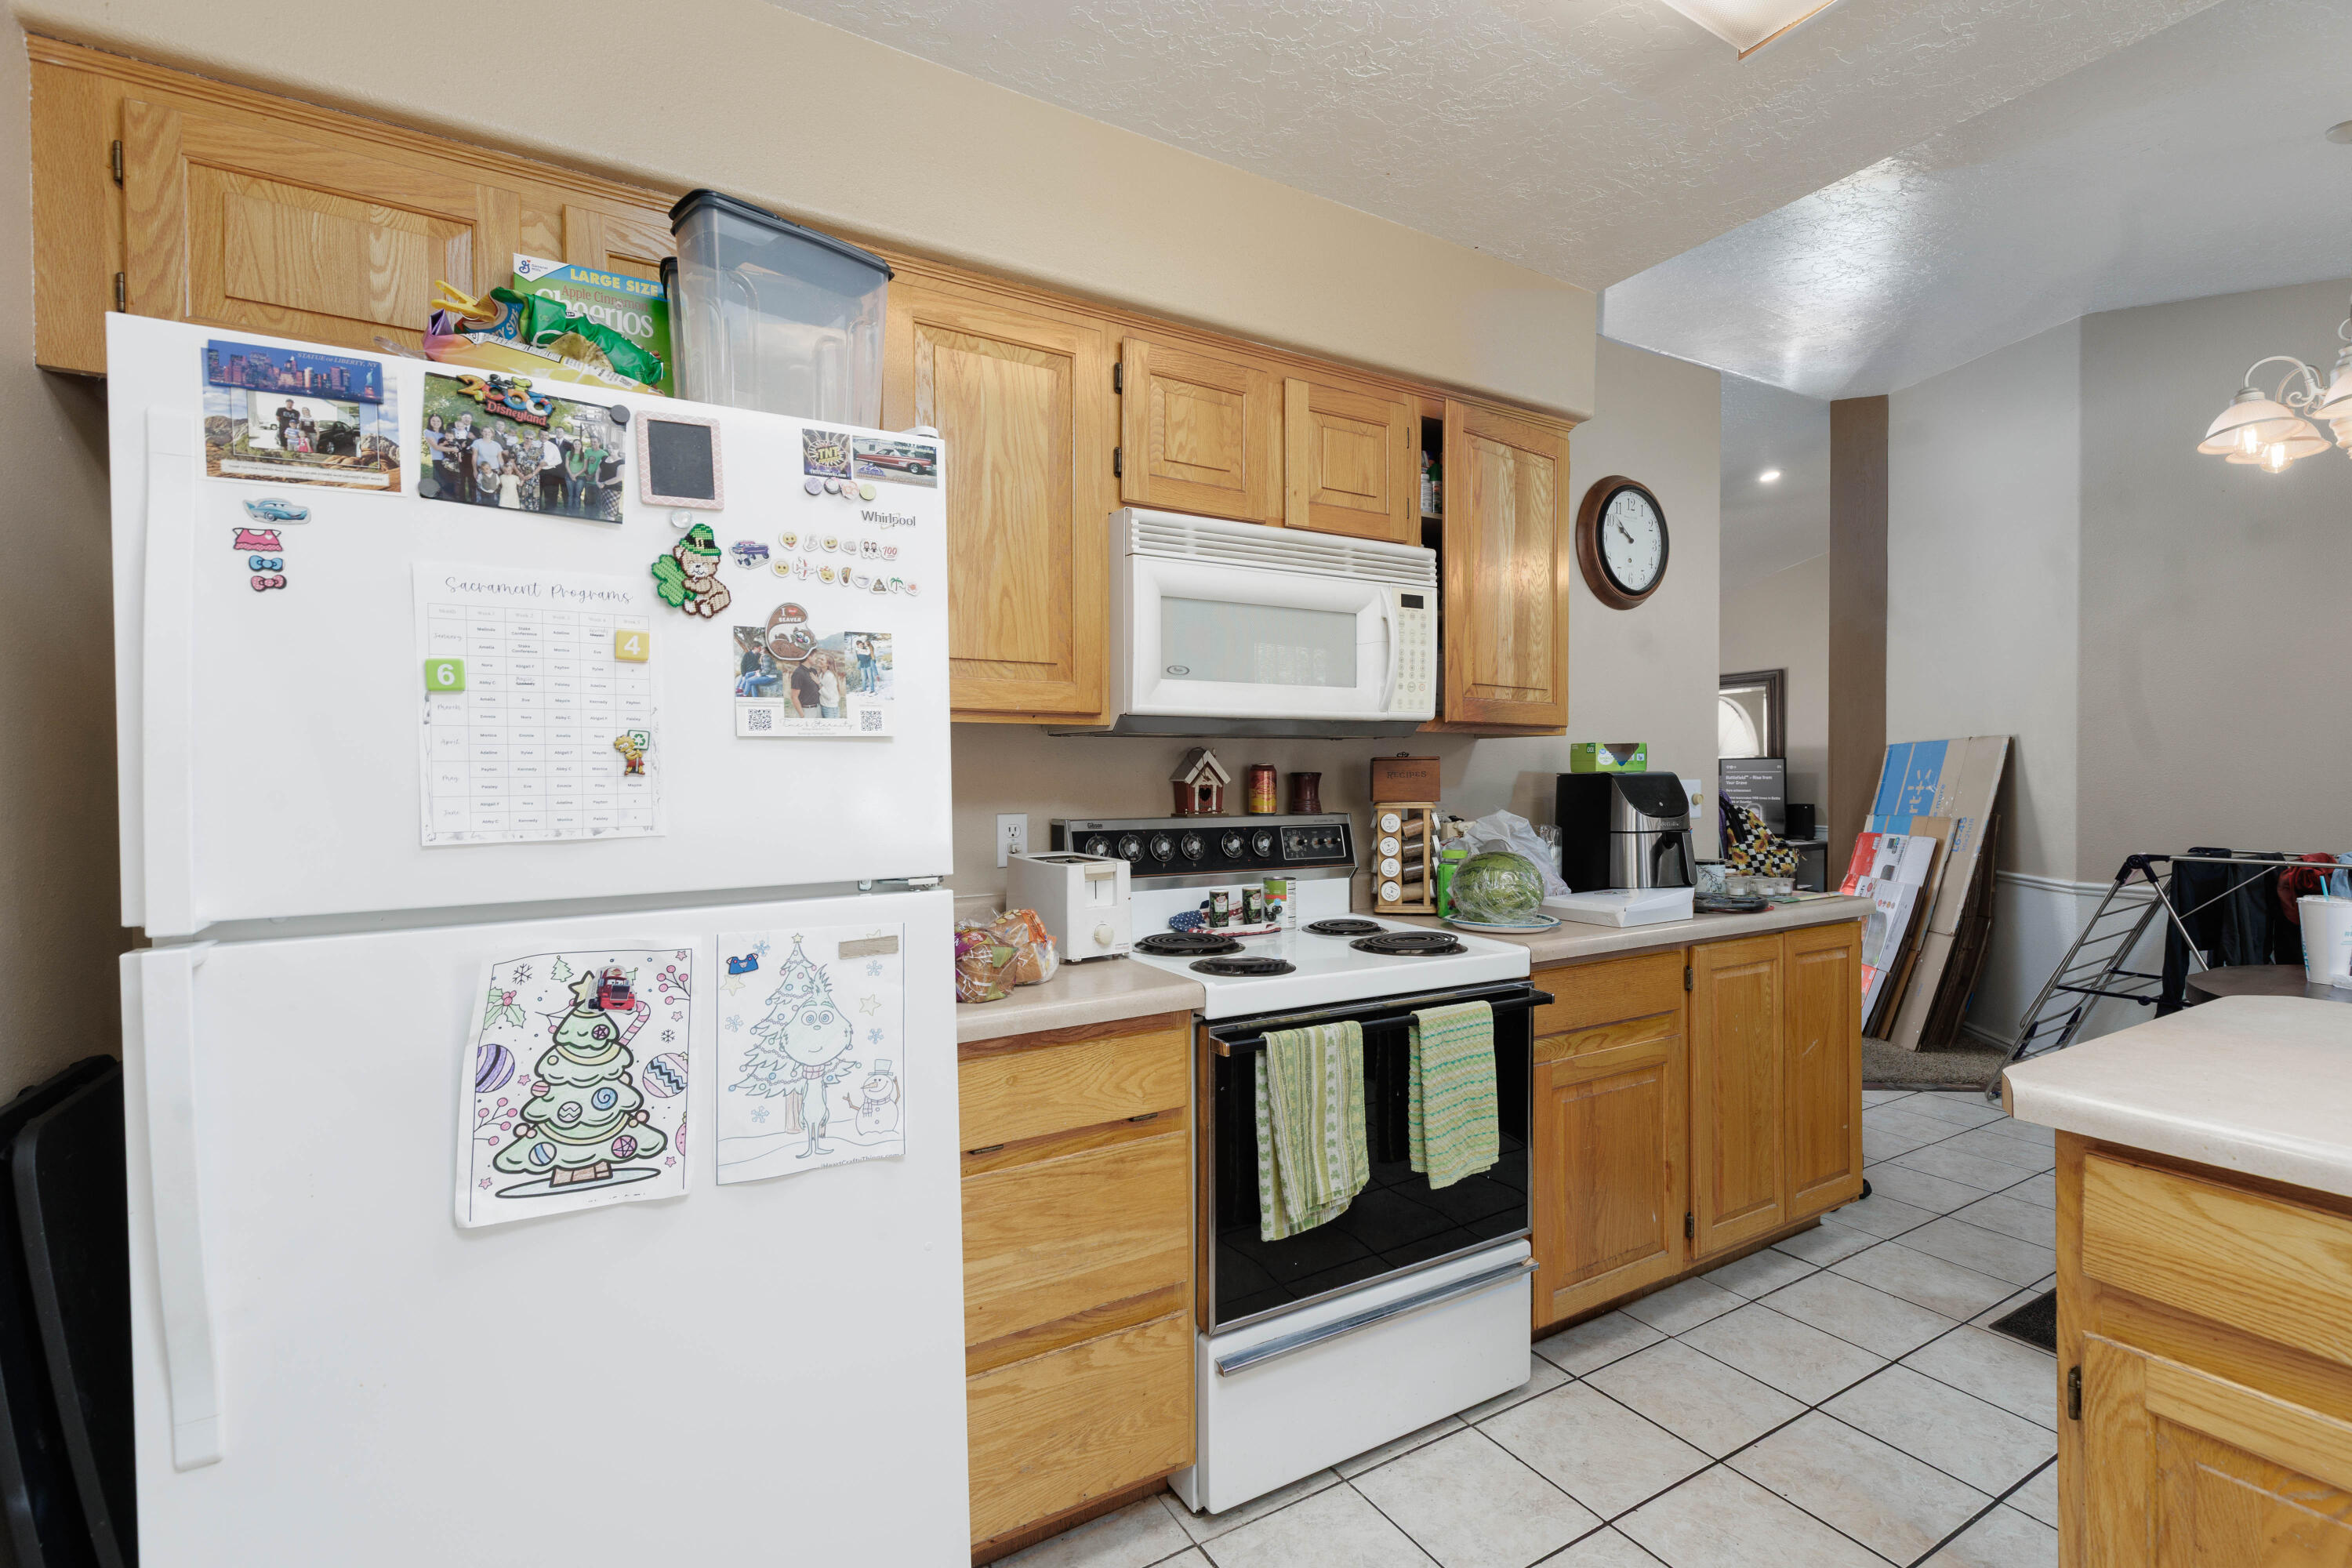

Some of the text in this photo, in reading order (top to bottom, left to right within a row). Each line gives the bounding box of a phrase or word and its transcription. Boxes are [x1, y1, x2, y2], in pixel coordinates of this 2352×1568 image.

[570, 268, 659, 297] LARGE SIZE
[561, 285, 648, 312] Apple Cinnamon
[297, 352, 325, 362] STATUE
[334, 356, 365, 368] LIBERTY,
[486, 399, 548, 426] Disneyland
[818, 446, 838, 459] TNT
[1627, 498, 1636, 511] 12
[861, 510, 916, 528] Whirlpool
[883, 546, 898, 557] 100
[445, 576, 634, 604] Sacrament Programs
[623, 635, 641, 655] 4
[437, 662, 456, 686] 6
[1386, 771, 1428, 779] RECIPES
